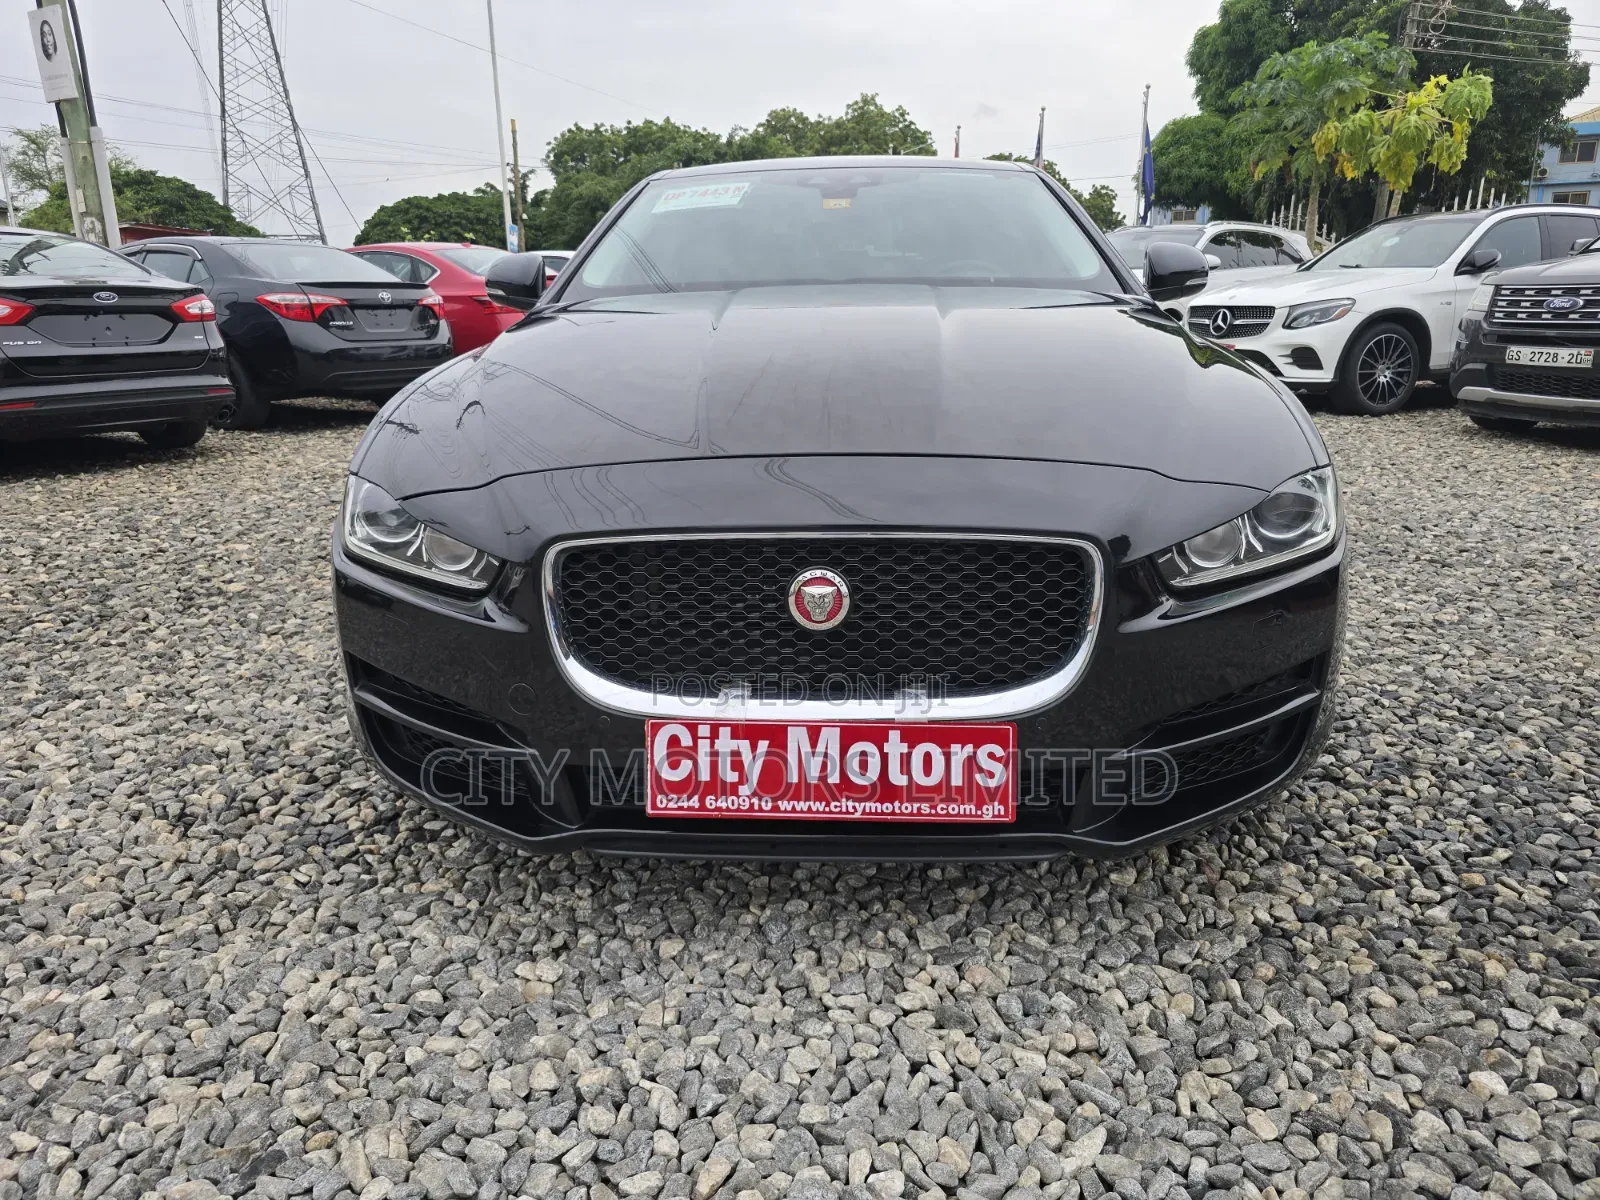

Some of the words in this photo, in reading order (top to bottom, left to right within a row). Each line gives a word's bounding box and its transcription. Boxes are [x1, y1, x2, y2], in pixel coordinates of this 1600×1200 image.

[1549, 298, 1574, 308] Ford
[1507, 349, 1522, 361] GS
[653, 723, 770, 796] City
[787, 726, 1007, 788] Motors
[656, 794, 700, 809] 0244
[705, 795, 773, 810] 640910
[778, 798, 1005, 818] www.citymotors.com.gh
